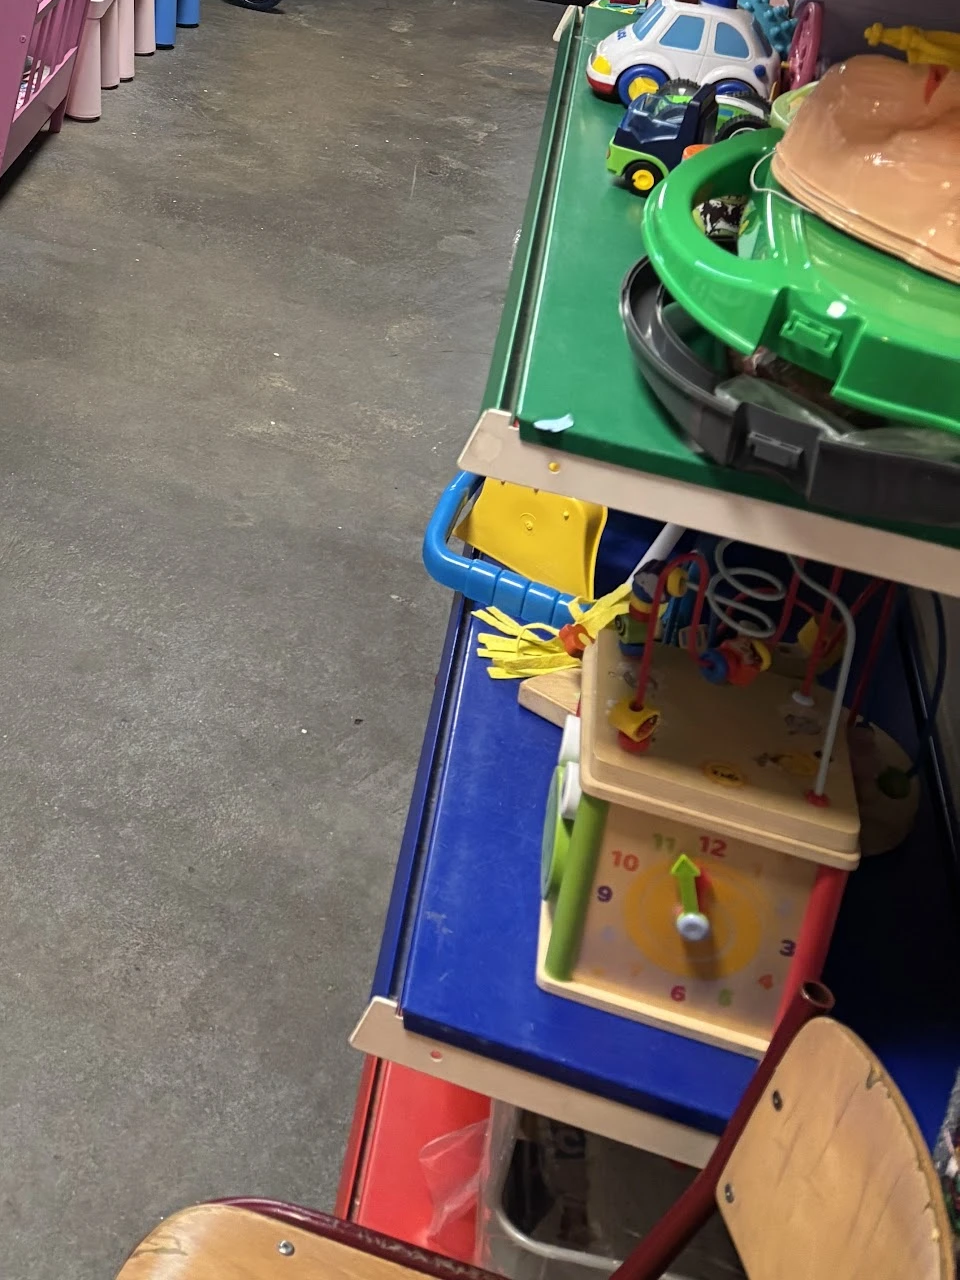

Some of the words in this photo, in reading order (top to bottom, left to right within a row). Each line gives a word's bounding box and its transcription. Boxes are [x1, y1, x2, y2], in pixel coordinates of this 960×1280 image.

[652, 833, 676, 852] 11
[699, 836, 728, 858] 12
[611, 850, 640, 872] 10
[597, 885, 613, 903] 9
[779, 939, 797, 957] 3
[757, 973, 774, 990] 4
[670, 985, 686, 1002] 6
